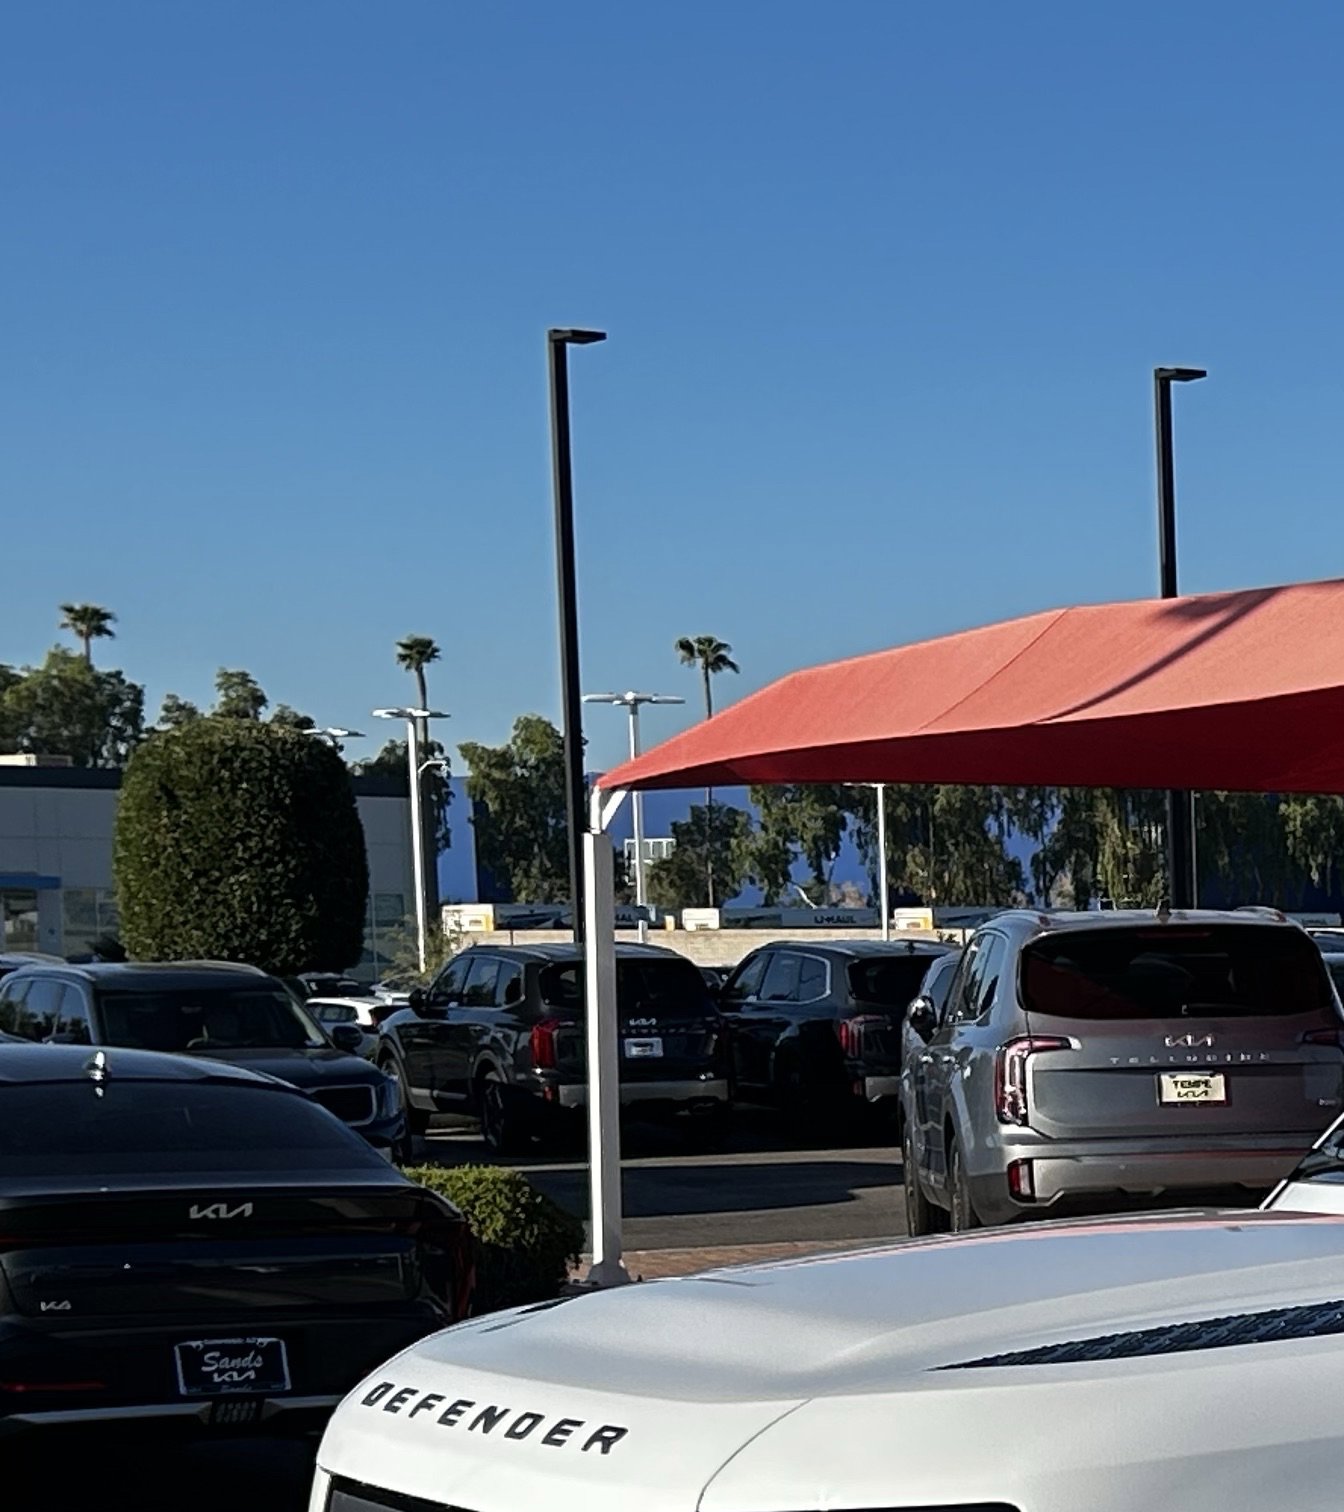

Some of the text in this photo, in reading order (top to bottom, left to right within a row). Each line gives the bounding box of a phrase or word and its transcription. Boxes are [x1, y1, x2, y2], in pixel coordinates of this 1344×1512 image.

[190, 1203, 253, 1219] KIA
[201, 1350, 263, 1372] Sands
[213, 1370, 256, 1382] KIA
[361, 1382, 629, 1455] DEFENDER
